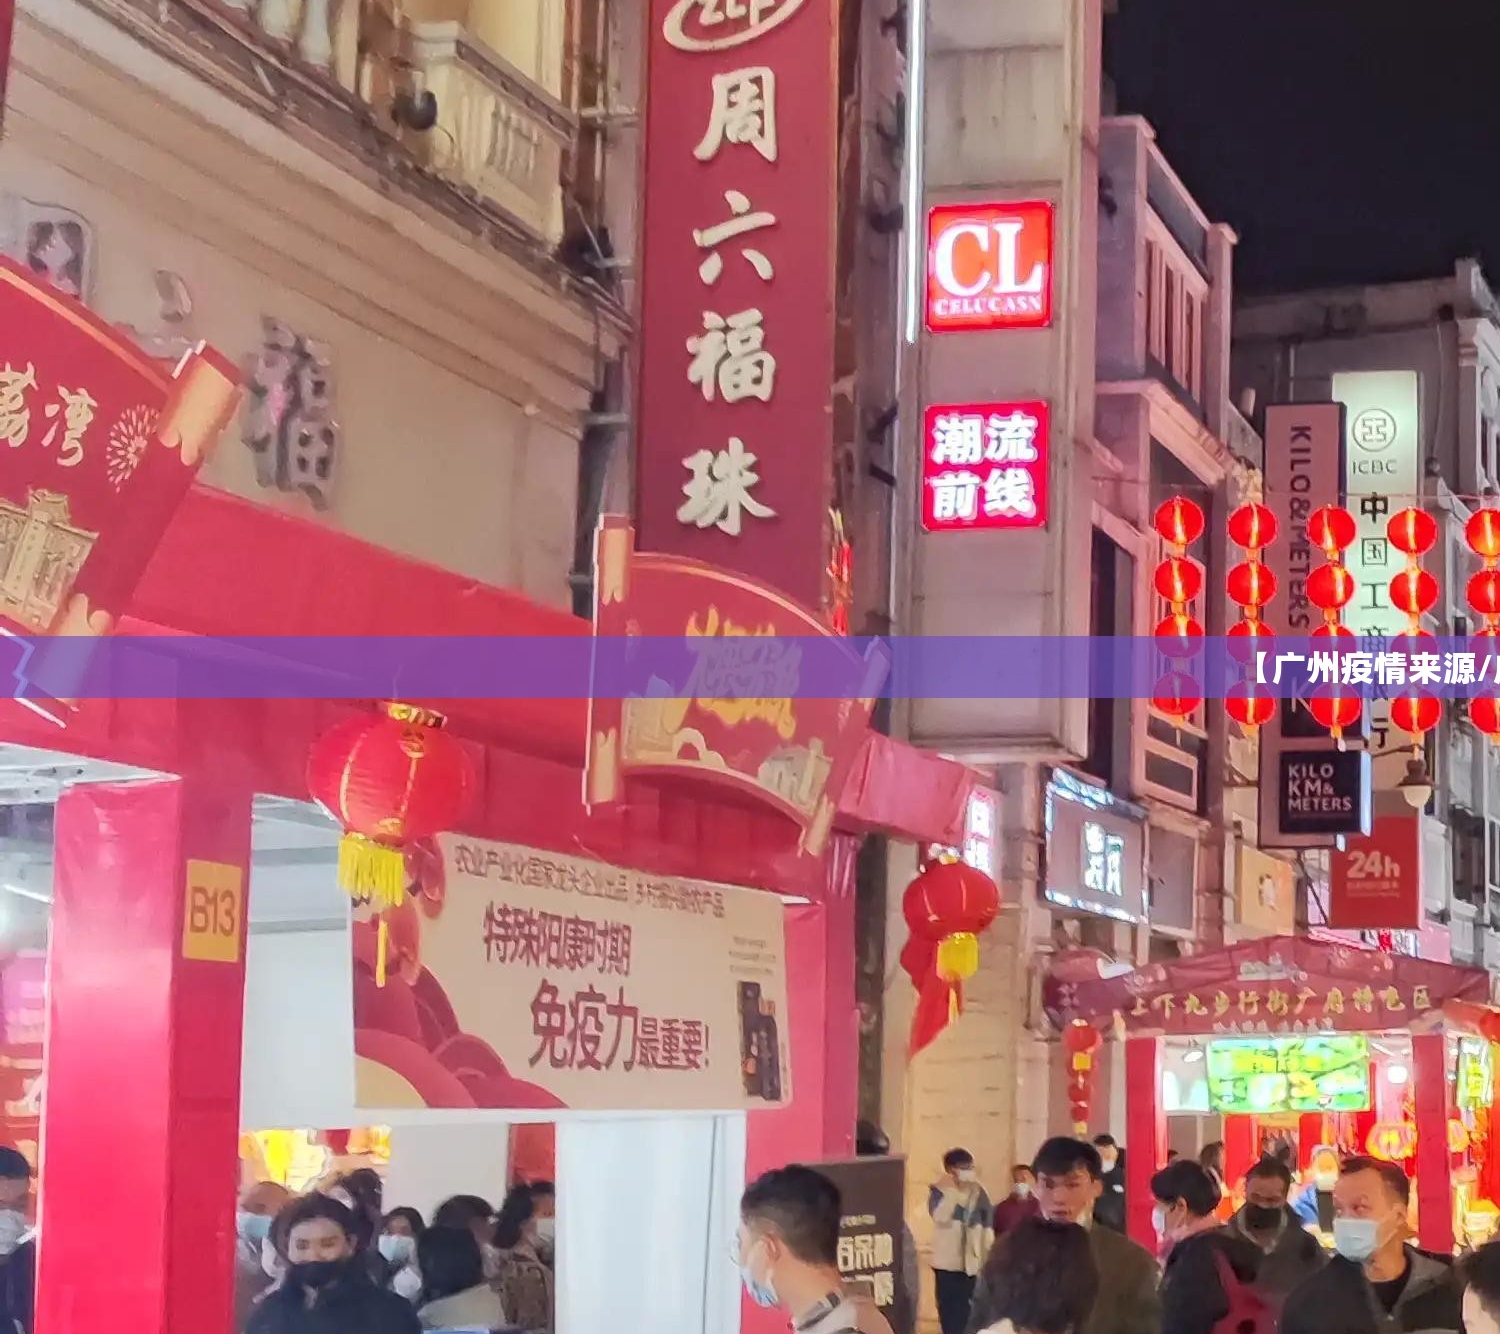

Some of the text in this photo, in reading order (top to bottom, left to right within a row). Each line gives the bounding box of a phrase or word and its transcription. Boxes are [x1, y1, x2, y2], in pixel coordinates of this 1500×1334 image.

[934, 219, 1044, 299] CL
[675, 65, 778, 537] 周六福珠
[931, 412, 1040, 466] 潮流
[1352, 459, 1398, 475] ICBC
[930, 468, 1036, 520] 前线
[1288, 763, 1334, 779] KILO
[1287, 796, 1353, 812] METERS
[1346, 850, 1401, 879] 24h
[190, 885, 236, 938] B13
[483, 900, 632, 977] 特殊阳康时期
